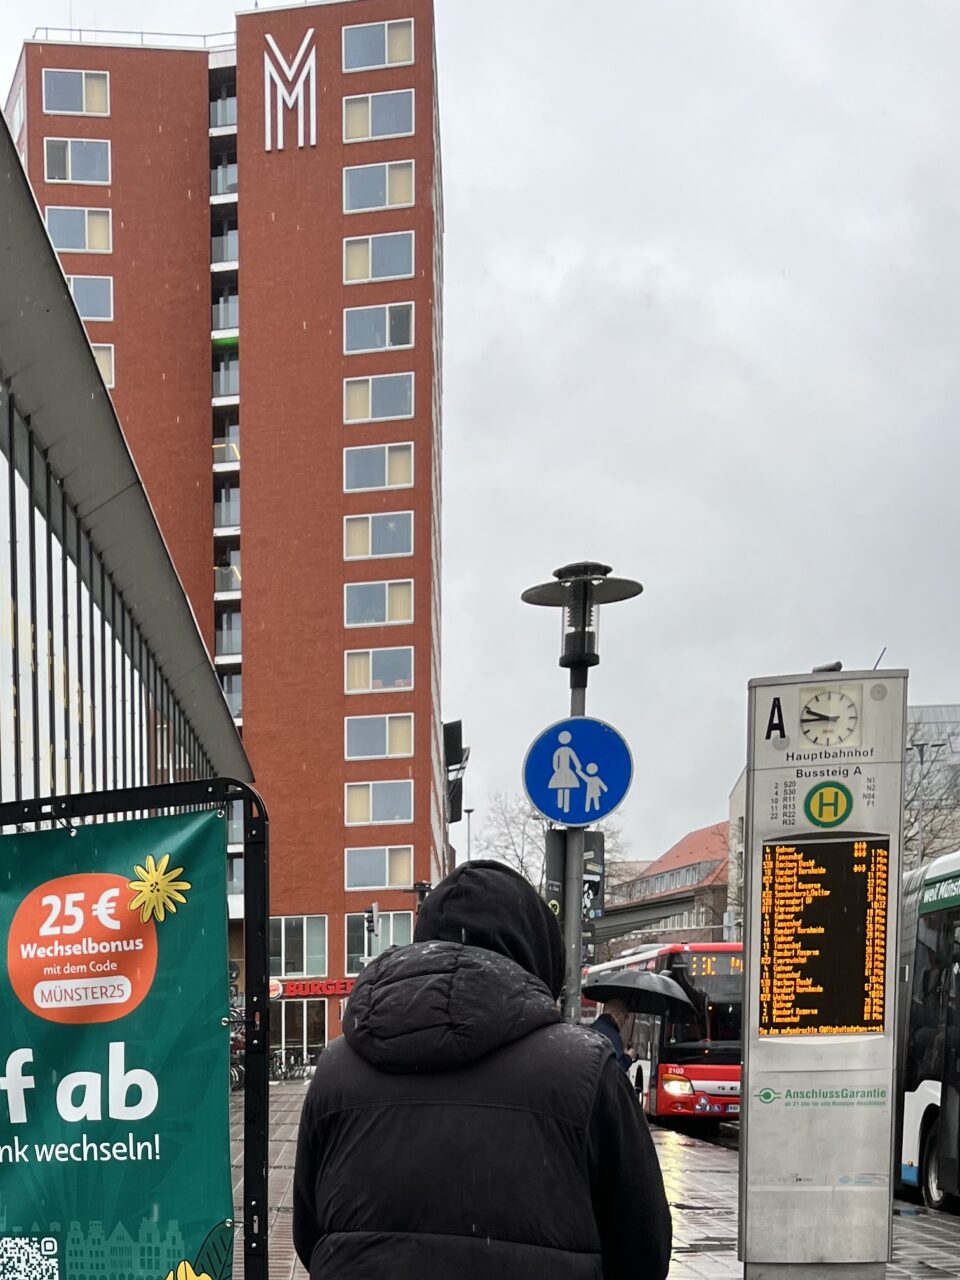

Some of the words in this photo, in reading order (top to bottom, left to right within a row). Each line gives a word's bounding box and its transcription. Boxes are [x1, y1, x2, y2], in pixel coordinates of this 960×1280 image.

[765, 697, 786, 740] A
[785, 748, 875, 762] Hauptbahnhof
[796, 767, 849, 779] Bussteig
[853, 766, 863, 776] A
[783, 780, 796, 788] S20
[783, 788, 796, 796] S30
[818, 791, 839, 818] H
[770, 812, 779, 820] 22
[39, 892, 85, 936] 25
[92, 888, 121, 930] €
[20, 937, 144, 959] Wechselbonus
[43, 963, 61, 975] mit
[63, 962, 87, 974] dem
[89, 960, 118, 972] Code
[40, 983, 125, 1004] MÜNSTER25
[56, 1041, 159, 1122] ab
[784, 1088, 887, 1099] AnschlussGarantie
[34, 1133, 161, 1162] wechseln!
